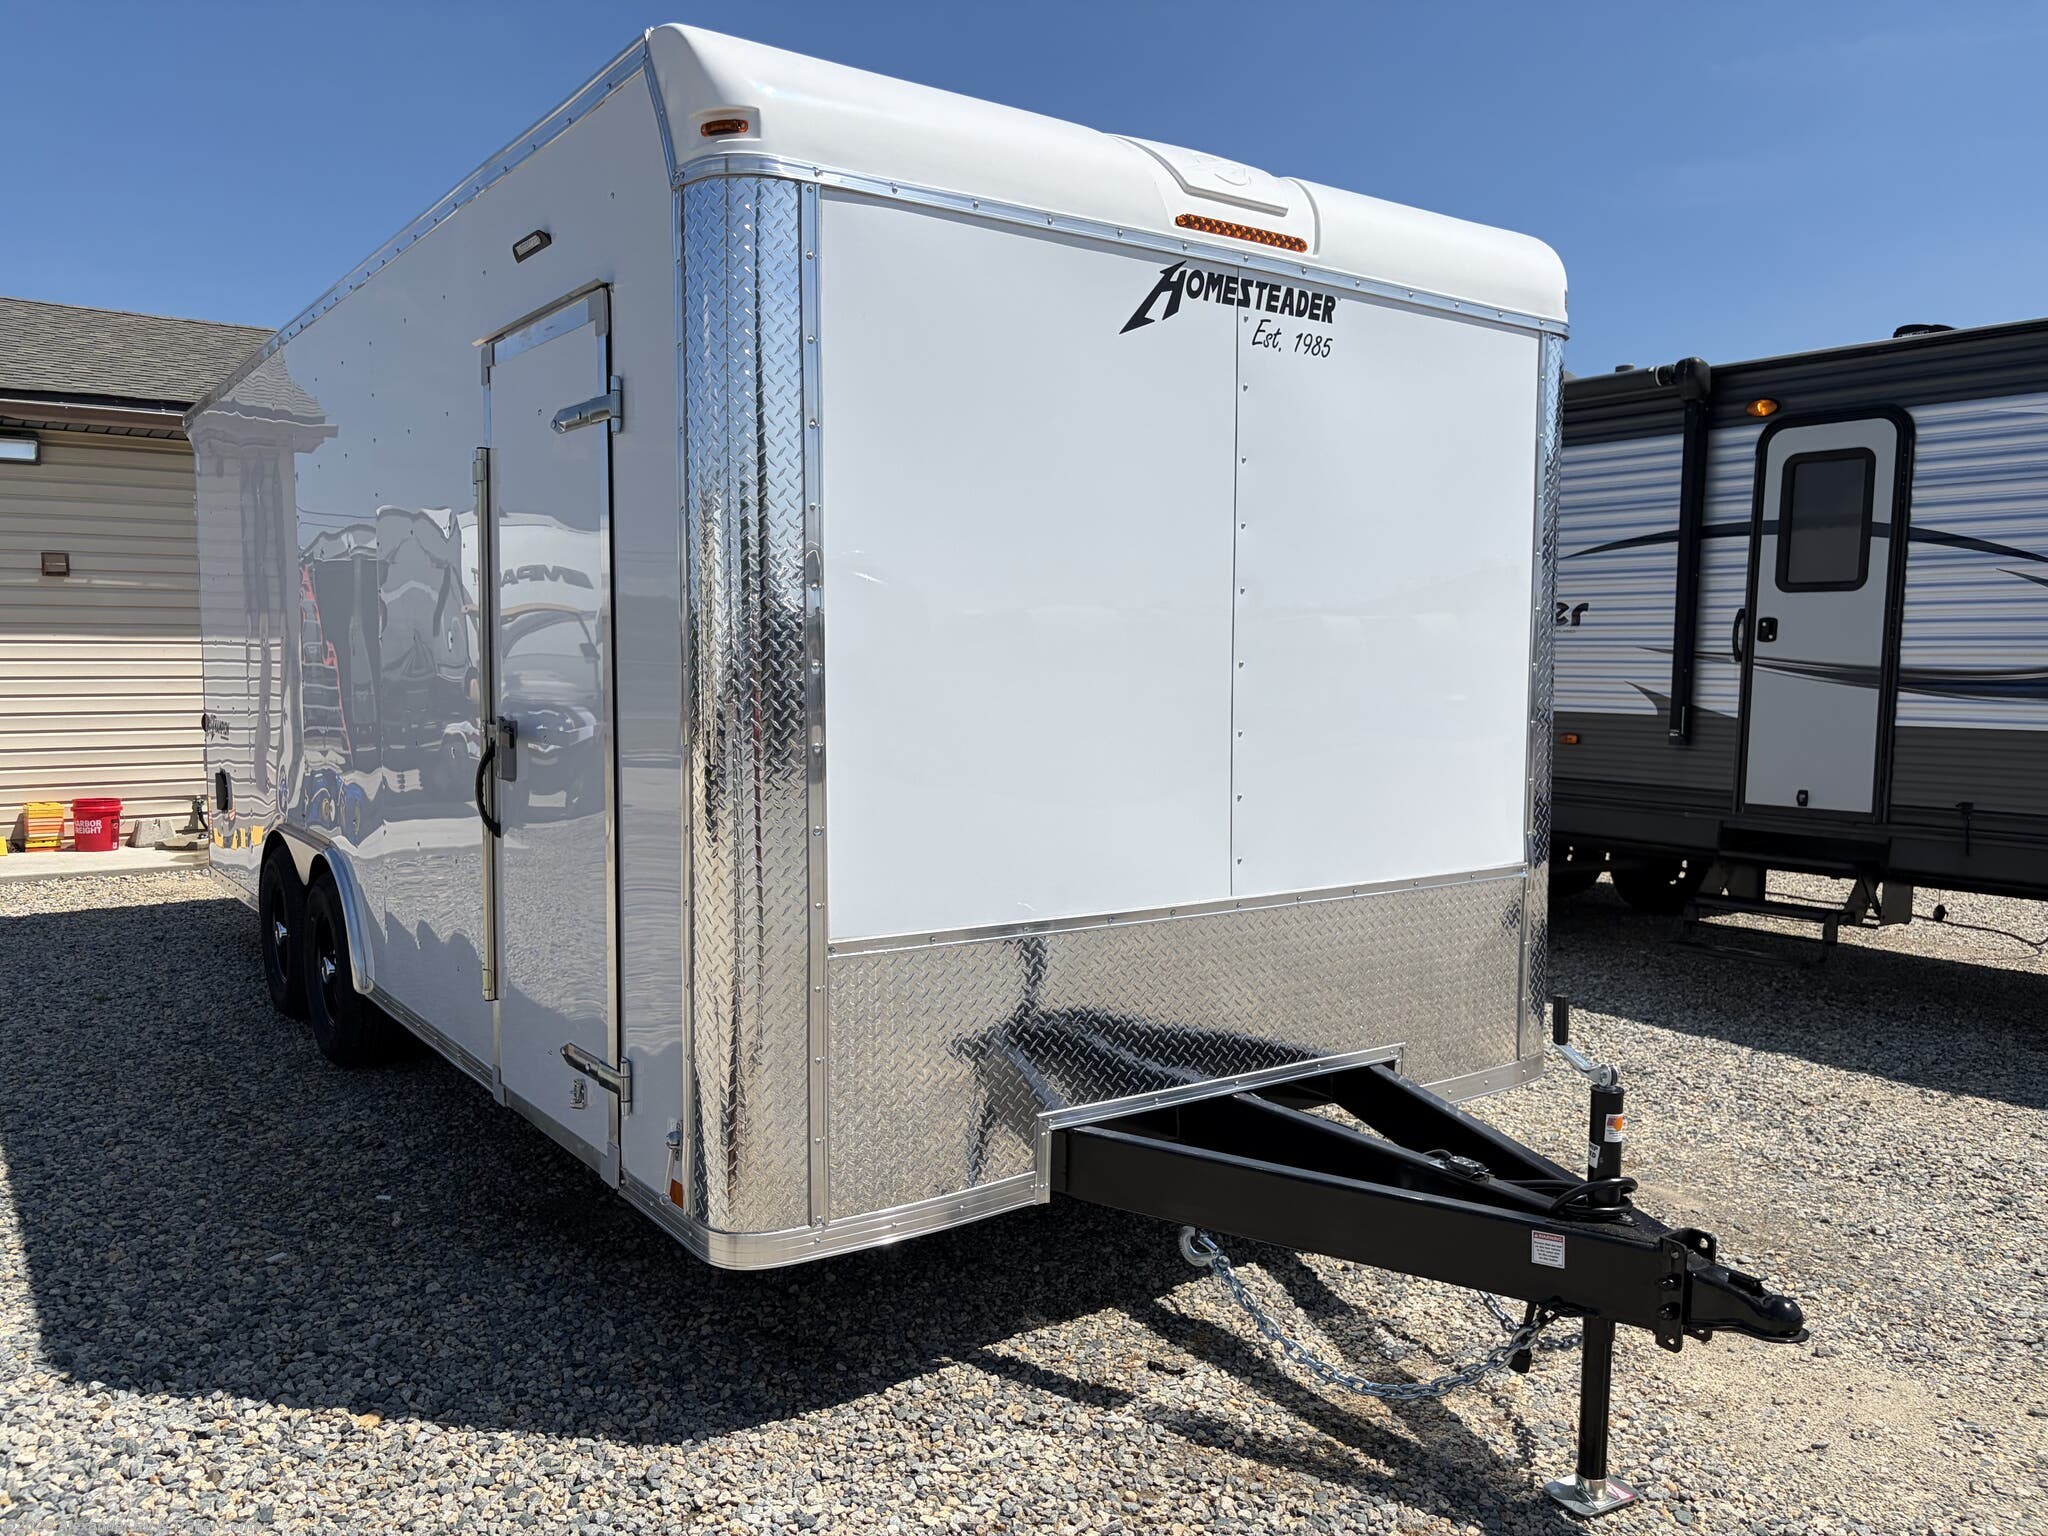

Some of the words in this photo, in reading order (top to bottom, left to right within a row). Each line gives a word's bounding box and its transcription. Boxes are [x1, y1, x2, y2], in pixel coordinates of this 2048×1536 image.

[1119, 260, 1337, 335] HOMESTEADER
[1294, 333, 1333, 358] 1985
[75, 820, 102, 828] ARBOR
[76, 826, 102, 834] REIGHT
